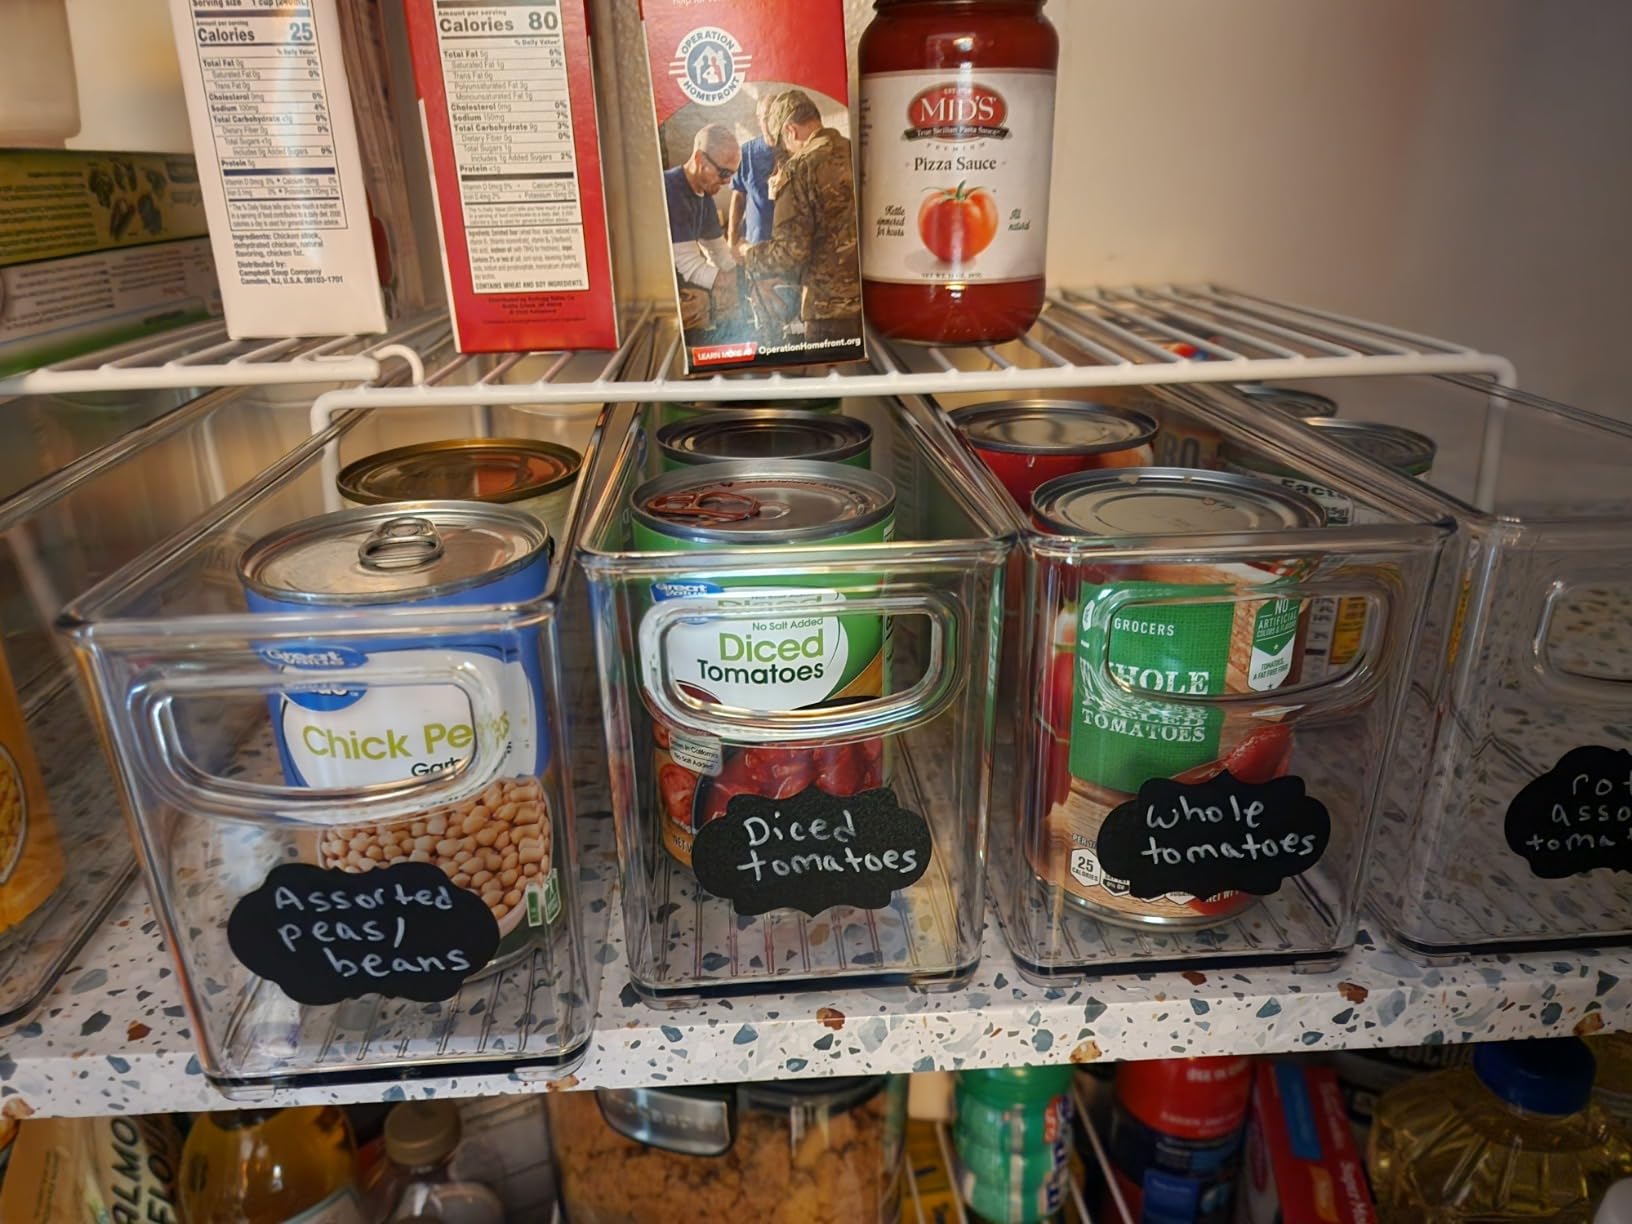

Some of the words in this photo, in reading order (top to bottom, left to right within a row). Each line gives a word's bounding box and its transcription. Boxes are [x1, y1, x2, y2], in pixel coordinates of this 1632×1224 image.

[439, 17, 515, 33] Calories
[528, 11, 559, 31] 80
[467, 10, 480, 18] per
[480, 9, 507, 17] serving
[197, 27, 255, 42] Calories
[289, 22, 313, 41] 25
[681, 30, 735, 54] OPERATION
[203, 59, 221, 67] Total
[222, 59, 235, 67] Fat
[306, 58, 318, 66] 0%
[465, 50, 479, 58] Fat
[484, 60, 496, 68] Fat
[308, 70, 320, 78] 0%
[208, 93, 250, 101] Cholesterol
[311, 92, 324, 100] 0%
[683, 76, 740, 103] HOMEFRONT
[211, 104, 238, 113] Sodium
[450, 103, 496, 112] Cholesterol
[920, 96, 996, 122] MID'S
[212, 115, 231, 124] Total
[232, 115, 280, 124] Carbohydrate
[315, 114, 327, 122] 0%
[452, 114, 482, 122] Sodium
[453, 124, 475, 132] Total
[475, 123, 528, 133] Carbohydrate
[221, 159, 247, 167] Protein
[460, 164, 488, 173] Protein
[914, 157, 952, 171] Pizza
[956, 156, 997, 171] Sauce
[239, 269, 270, 278] Campbell
[271, 269, 289, 278] Soup
[290, 268, 322, 277] Company
[758, 337, 861, 356] OperationHomefront.org
[1275, 599, 1289, 615] NO
[752, 621, 767, 631] No
[768, 619, 788, 631] Salt
[790, 617, 824, 629] Added
[1114, 617, 1176, 637] GROCERS
[1257, 609, 1298, 630] ARTIFICIAL
[719, 628, 825, 663] Diced
[697, 659, 824, 685] Tomatoes
[1108, 661, 1210, 695] HOLE
[1081, 708, 1206, 742] TOMATOES
[302, 725, 413, 761] Chick
[743, 809, 856, 847] Diced
[1140, 832, 1318, 865] tomatoes
[737, 847, 918, 881] tomatoes
[1078, 856, 1094, 873] 25
[1071, 867, 1099, 882] CALORIES
[274, 884, 454, 912] Assorted
[322, 948, 472, 978] beans
